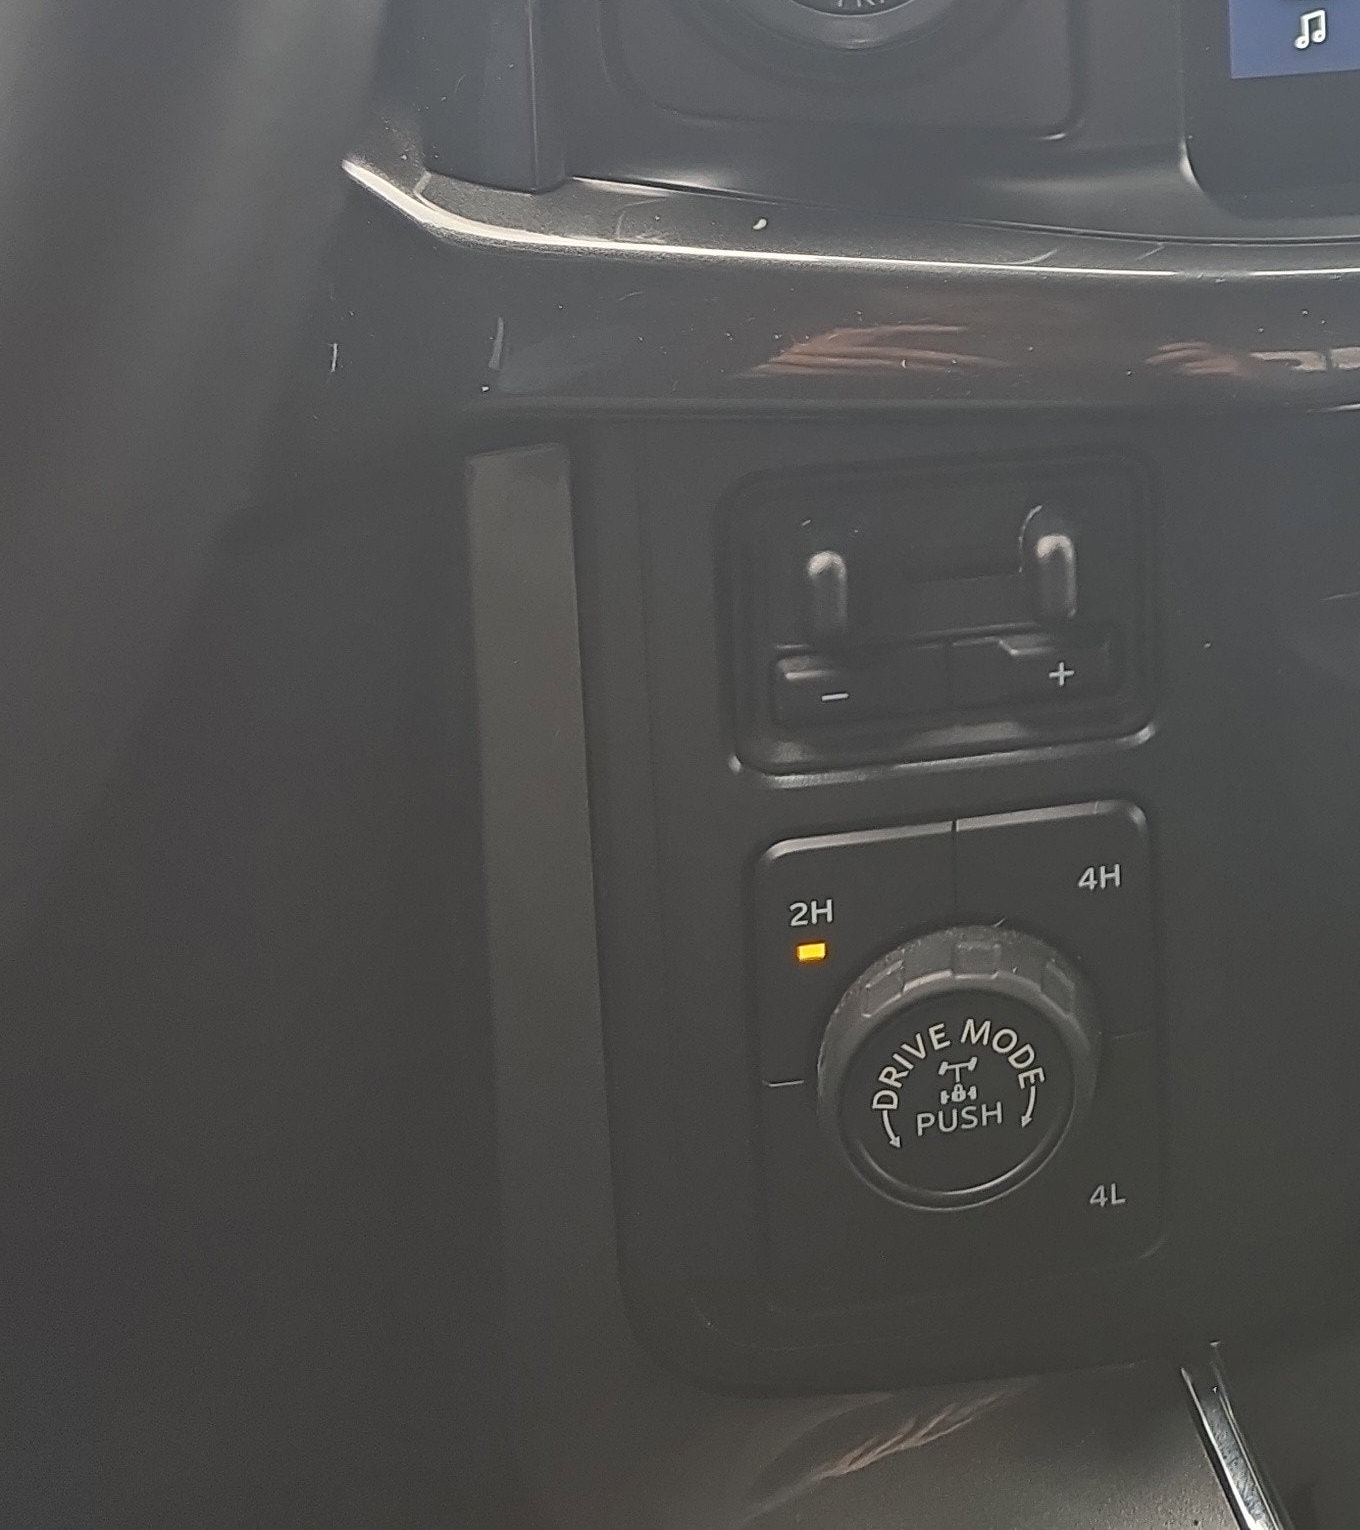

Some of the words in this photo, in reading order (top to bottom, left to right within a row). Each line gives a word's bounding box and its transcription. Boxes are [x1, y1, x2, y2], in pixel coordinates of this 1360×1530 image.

[1077, 863, 1123, 891] 4H
[788, 898, 835, 928] 2H
[872, 1022, 951, 1111] DRIVE
[959, 1017, 1046, 1090] MODE
[915, 1101, 1005, 1137] PUSH
[1088, 1182, 1127, 1208] 4L
